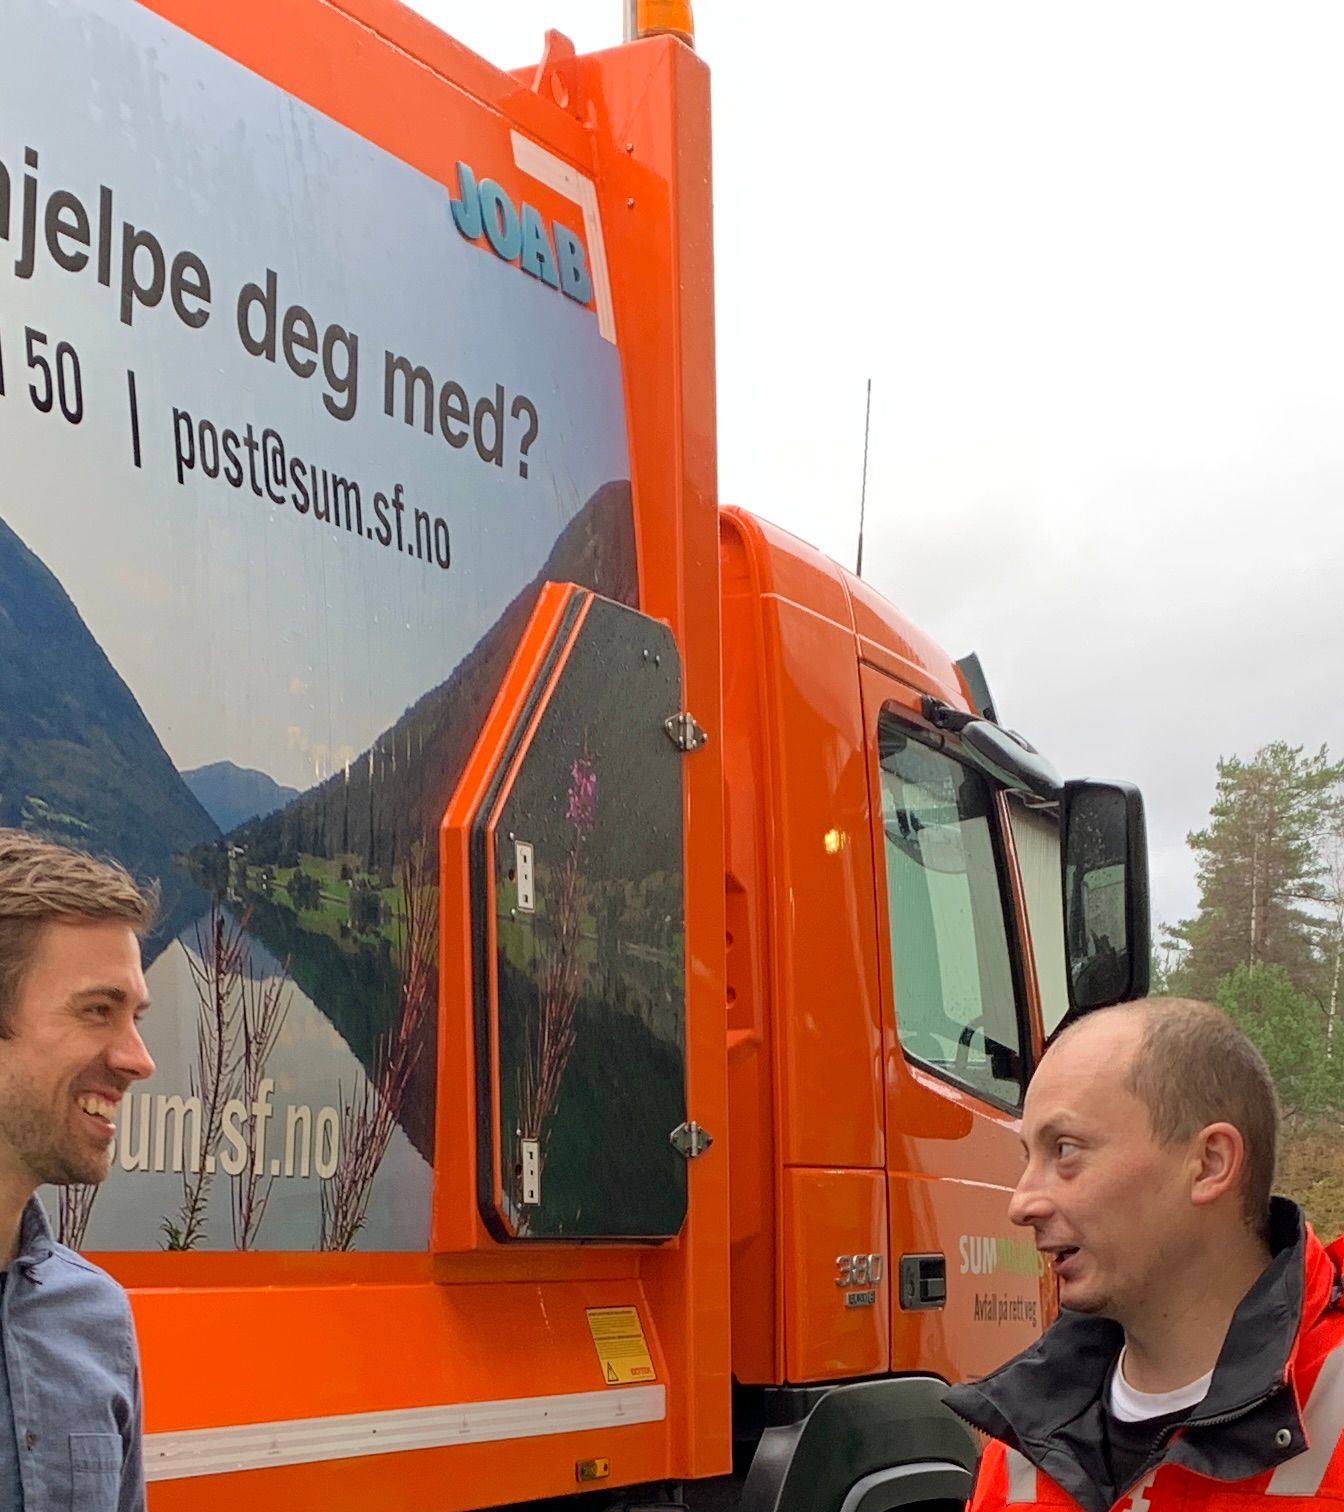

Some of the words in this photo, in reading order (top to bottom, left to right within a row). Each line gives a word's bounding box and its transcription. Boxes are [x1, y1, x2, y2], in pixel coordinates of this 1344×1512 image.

[448, 160, 592, 305] JOAB
[236, 267, 359, 421] deg
[384, 349, 540, 479] med?
[25, 325, 84, 425] 50
[172, 406, 452, 571] post@sum.sf.no
[109, 1077, 340, 1180] um.sf.no
[974, 1293, 997, 1321] Avfall
[998, 1293, 1008, 1327] på
[1009, 1296, 1024, 1321] rett
[1024, 1301, 1037, 1328] veg
